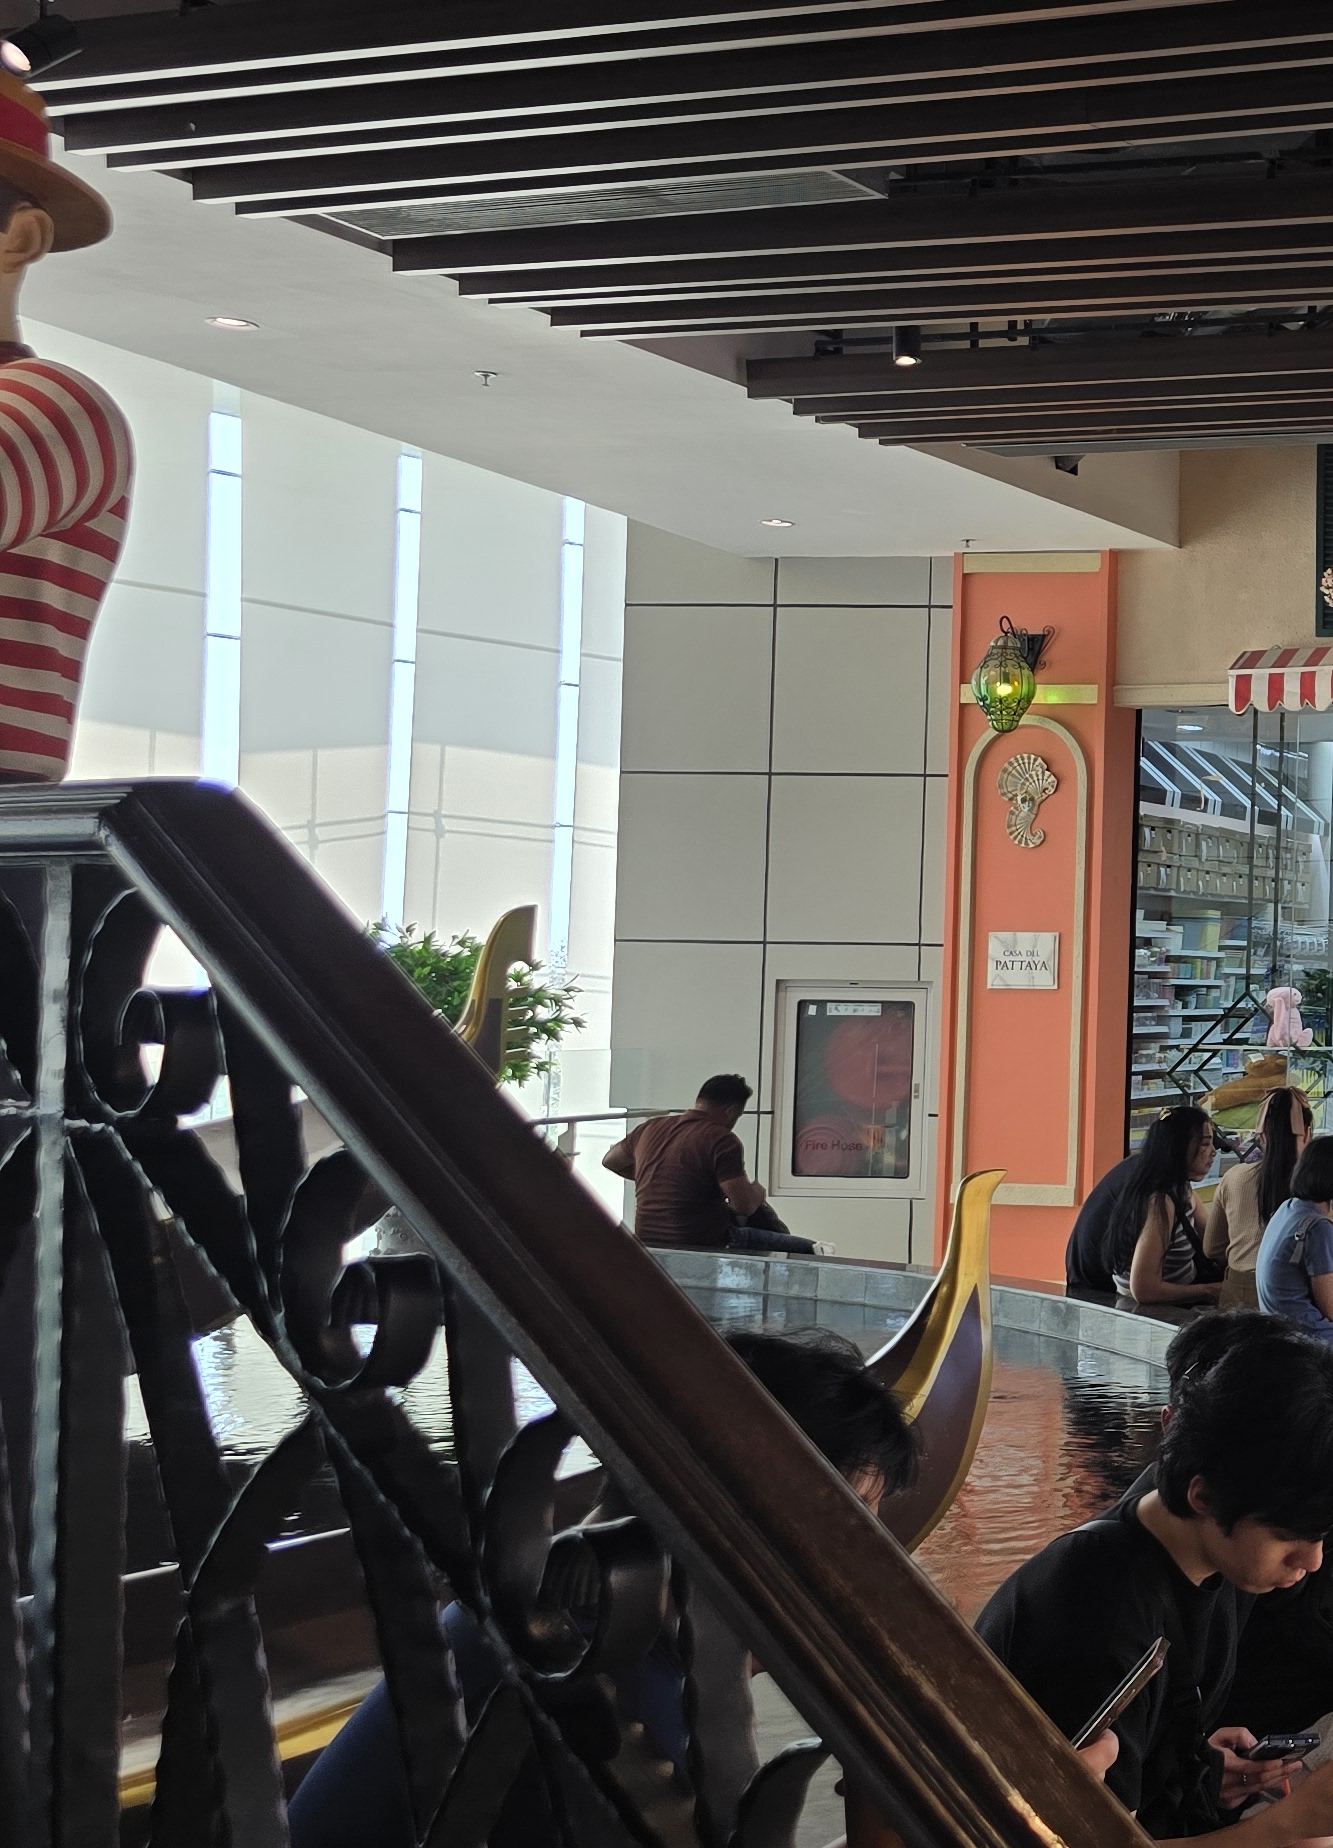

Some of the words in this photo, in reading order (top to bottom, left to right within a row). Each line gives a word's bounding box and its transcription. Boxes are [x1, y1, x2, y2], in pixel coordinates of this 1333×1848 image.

[1003, 949, 1022, 957] CASA
[995, 960, 1048, 971] PATTAYA
[804, 1140, 828, 1151] Fire
[832, 1140, 863, 1151] Hose
